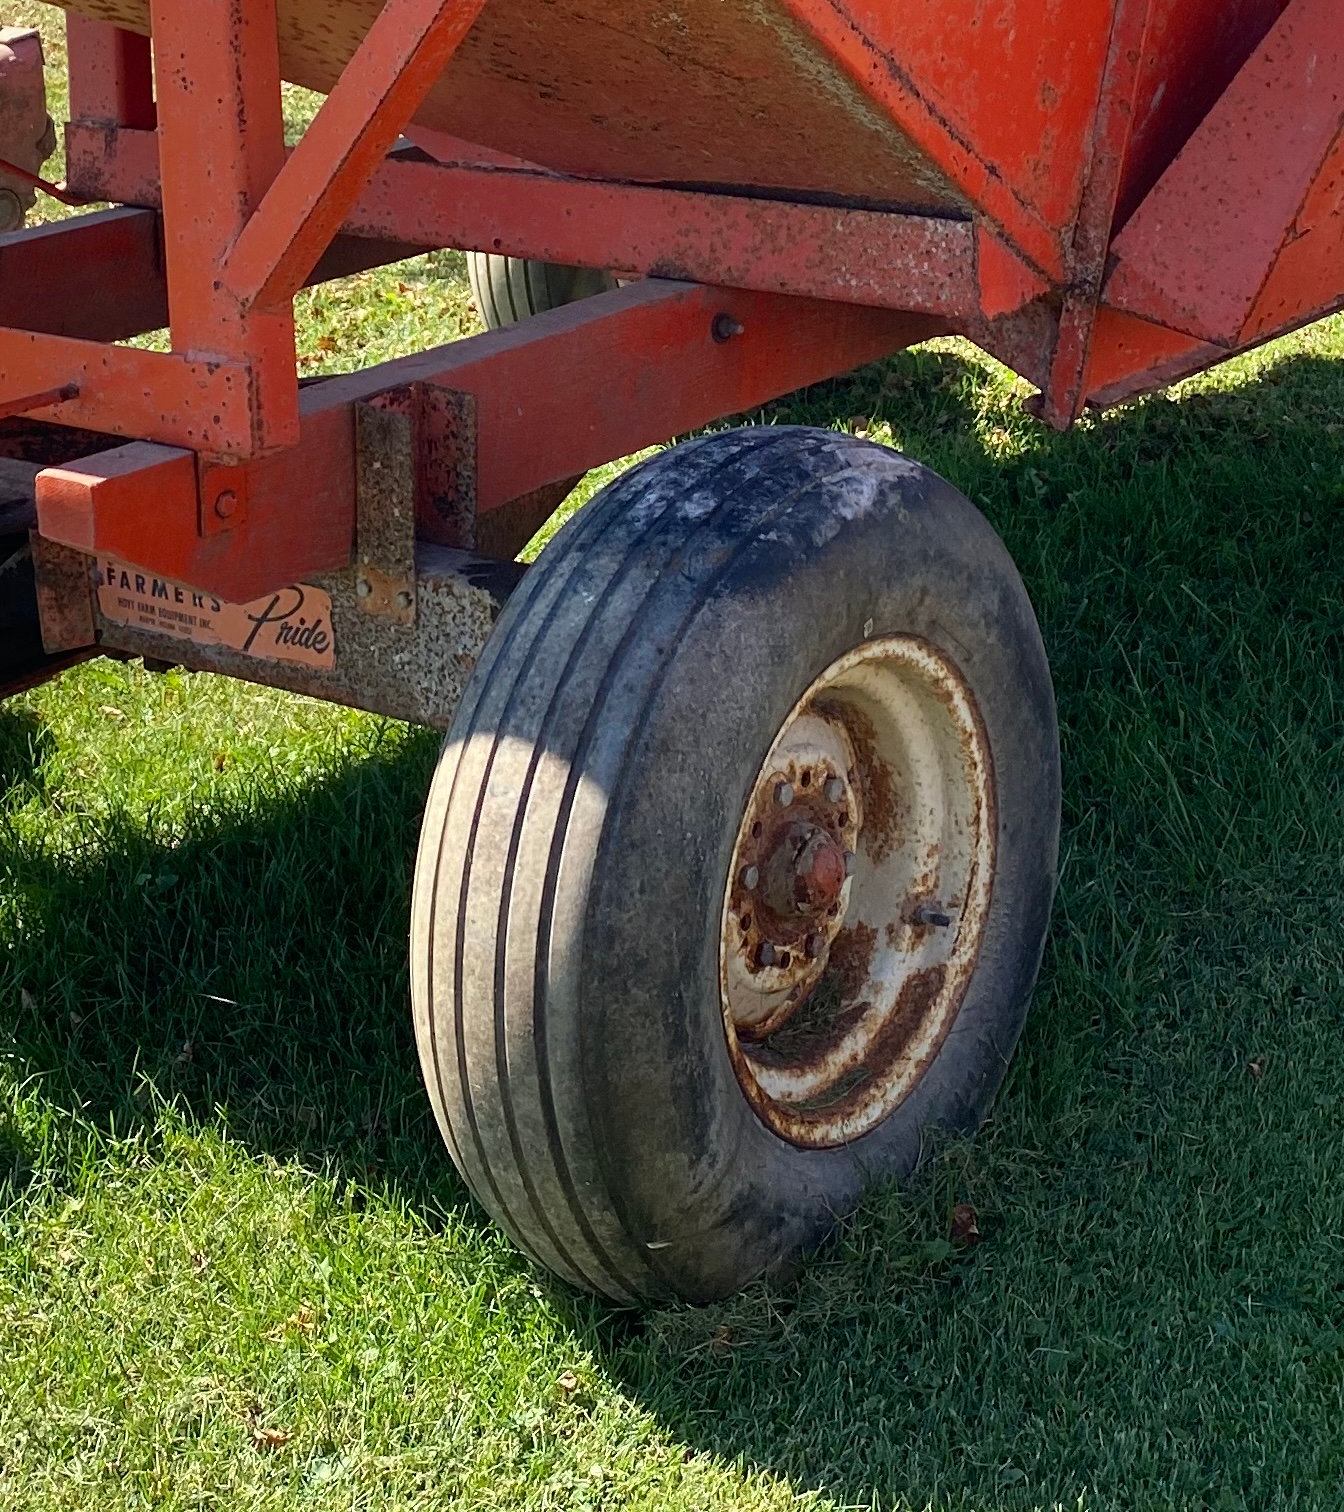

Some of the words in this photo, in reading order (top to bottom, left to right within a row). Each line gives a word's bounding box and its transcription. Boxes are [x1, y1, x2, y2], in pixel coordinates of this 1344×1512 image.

[106, 564, 222, 613] FARMERS
[137, 602, 156, 616] FARM
[158, 607, 198, 626] EQUIPMENT
[242, 585, 332, 655] Pride
